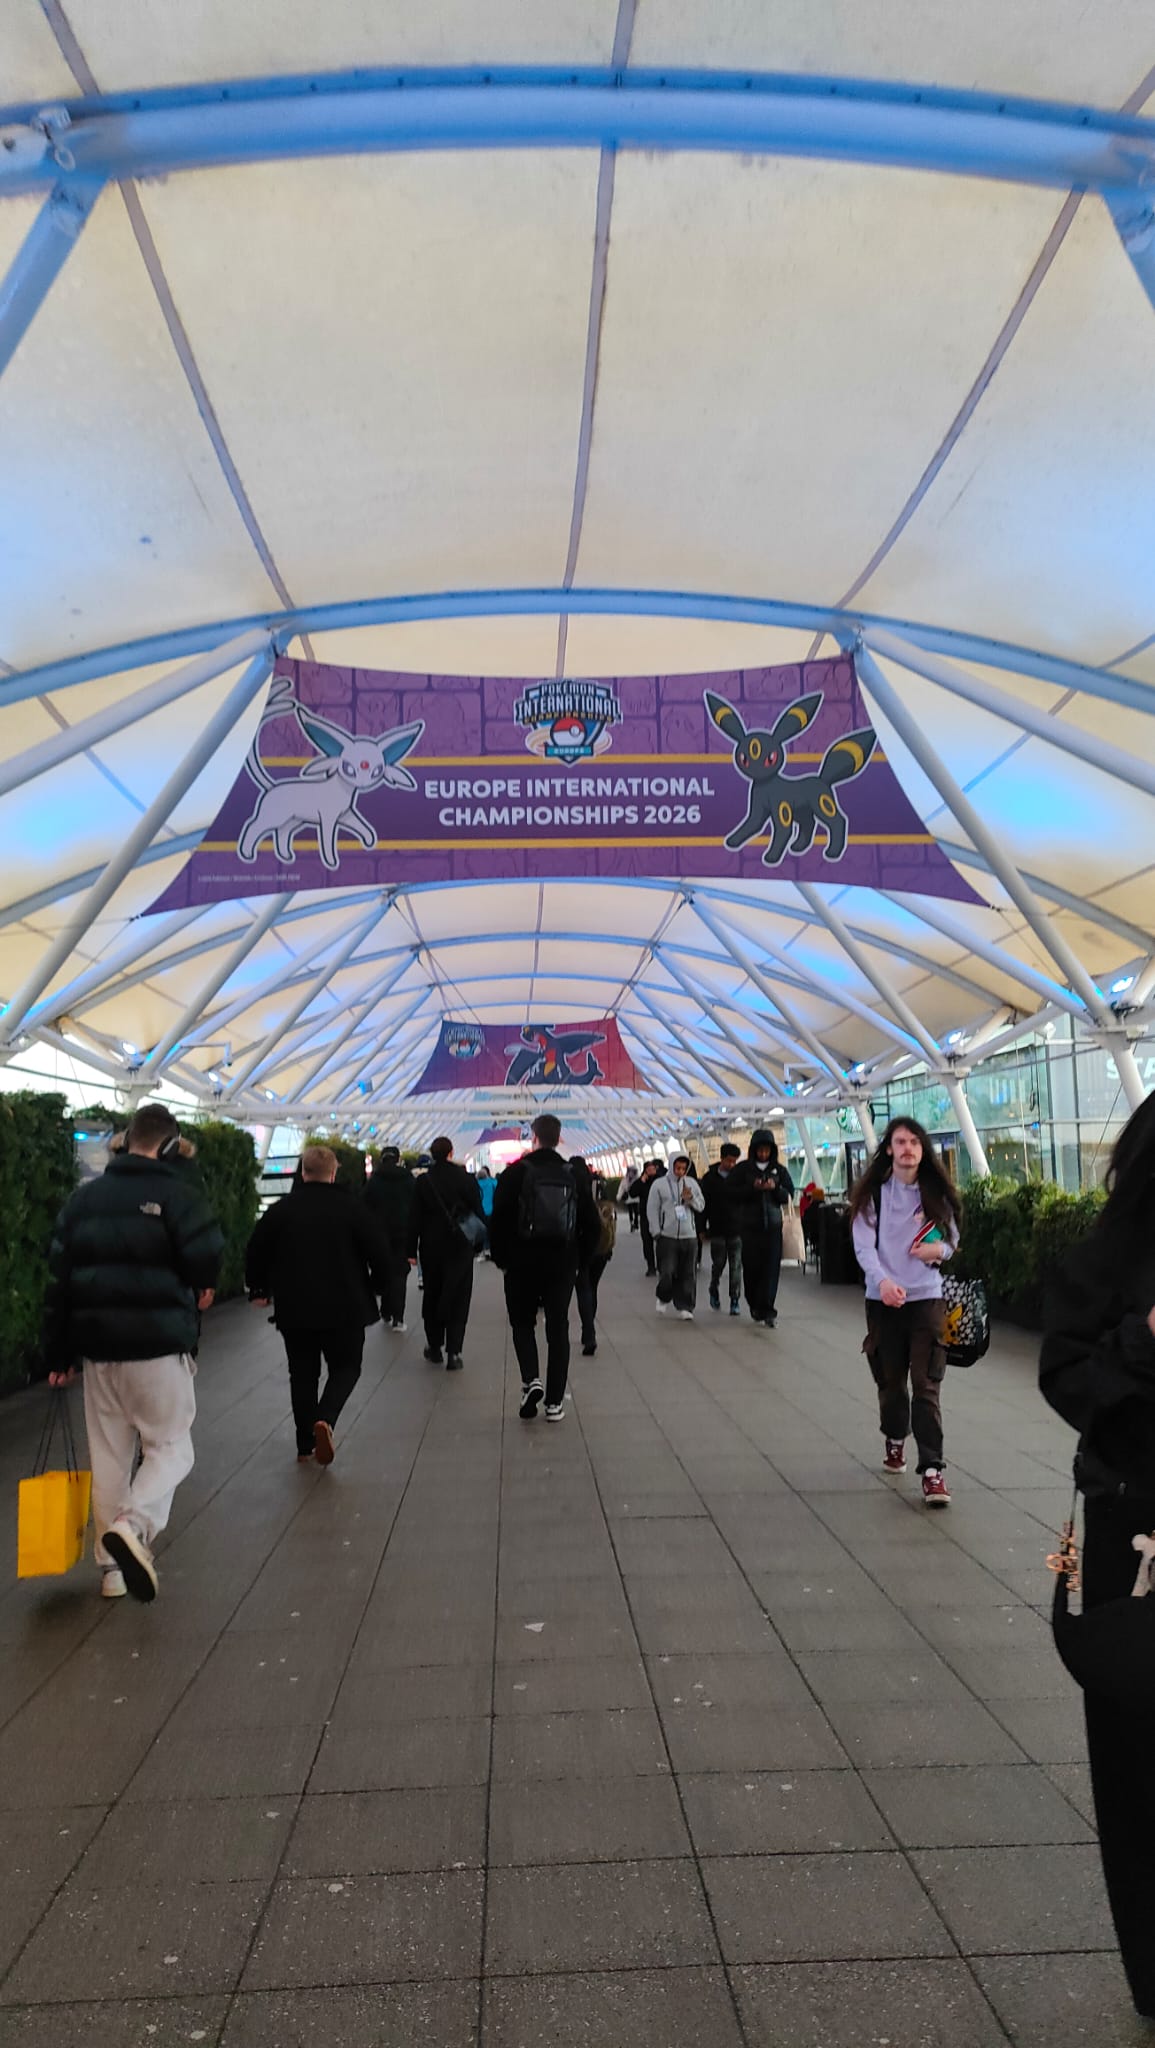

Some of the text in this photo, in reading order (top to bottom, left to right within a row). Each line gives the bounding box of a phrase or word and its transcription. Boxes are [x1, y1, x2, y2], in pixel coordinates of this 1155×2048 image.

[516, 695, 620, 720] INTERNATIONAL
[424, 777, 715, 799] EUROPE INTERNATIONAL
[438, 805, 702, 826] CHAMPIONSHIPS 2026
